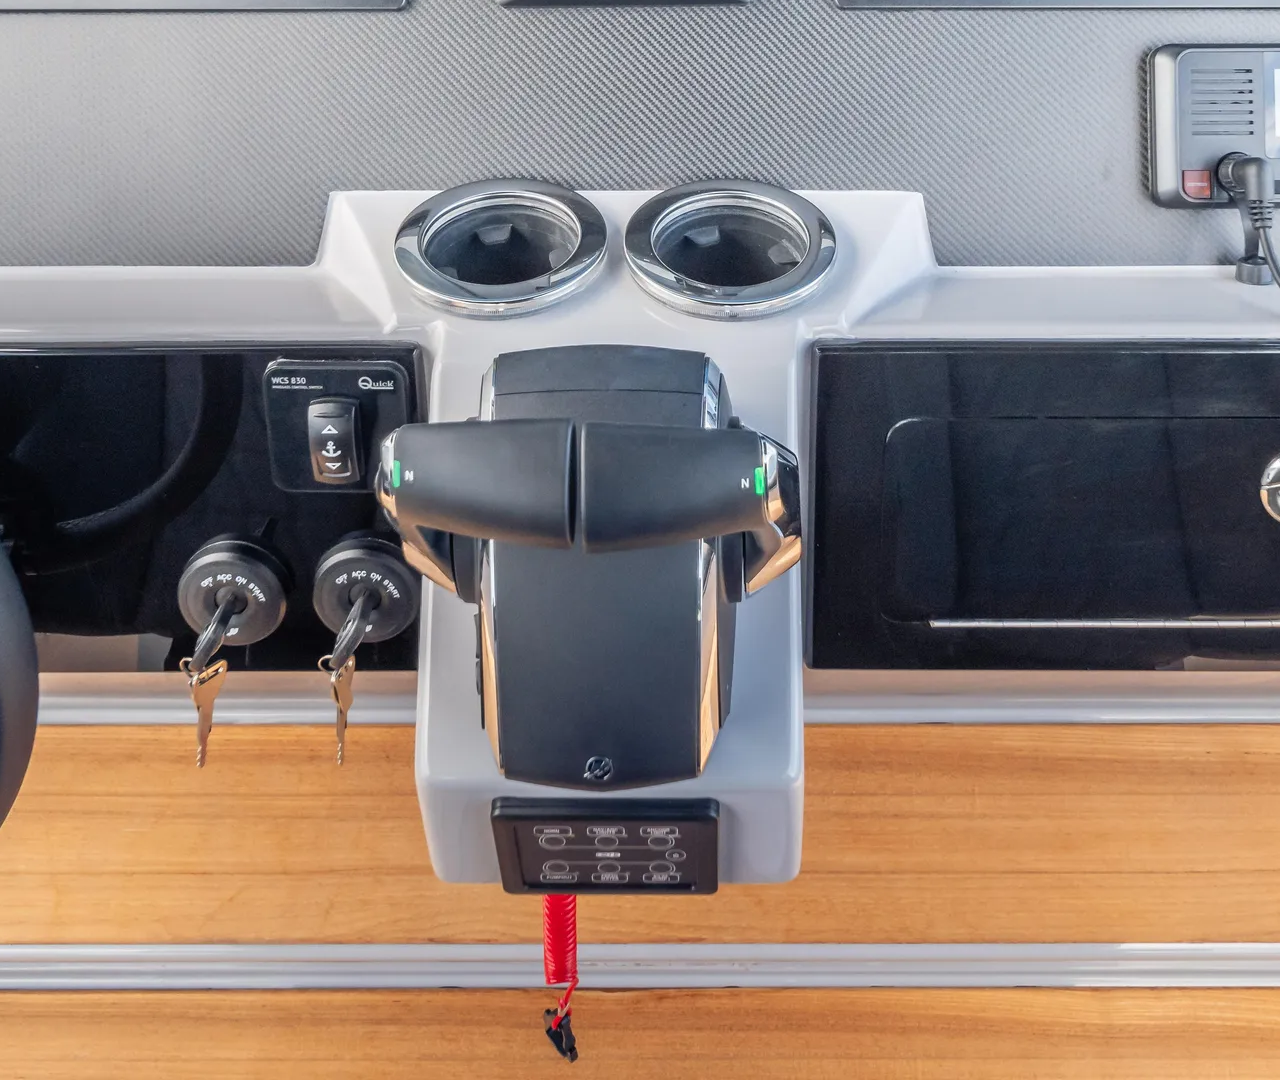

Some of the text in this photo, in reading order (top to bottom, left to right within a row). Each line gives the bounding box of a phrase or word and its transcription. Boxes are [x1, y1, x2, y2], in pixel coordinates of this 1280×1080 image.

[358, 376, 394, 390] Quick
[404, 470, 414, 480] N
[741, 478, 750, 488] N
[235, 575, 248, 585] ON
[247, 583, 266, 603] START
[370, 572, 382, 582] ON
[383, 579, 401, 599] START
